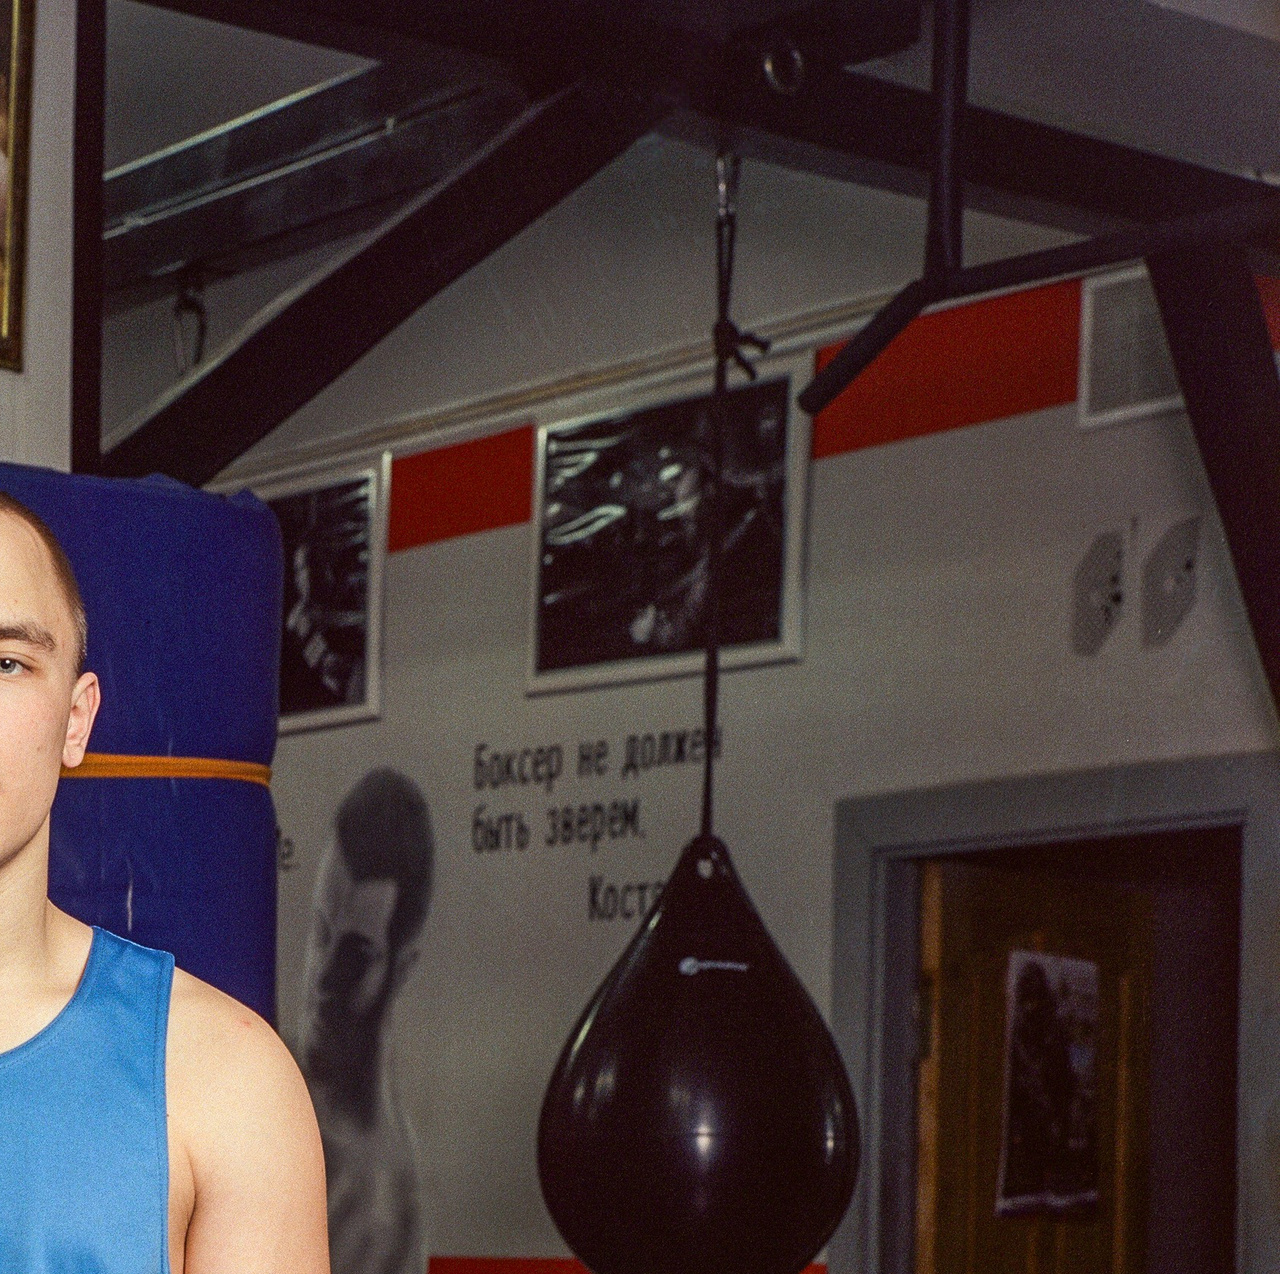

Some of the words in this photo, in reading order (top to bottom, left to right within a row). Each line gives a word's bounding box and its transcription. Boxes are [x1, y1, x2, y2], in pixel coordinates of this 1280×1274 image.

[473, 742, 563, 793] Боксер
[577, 738, 609, 778] не
[472, 803, 530, 853] быть
